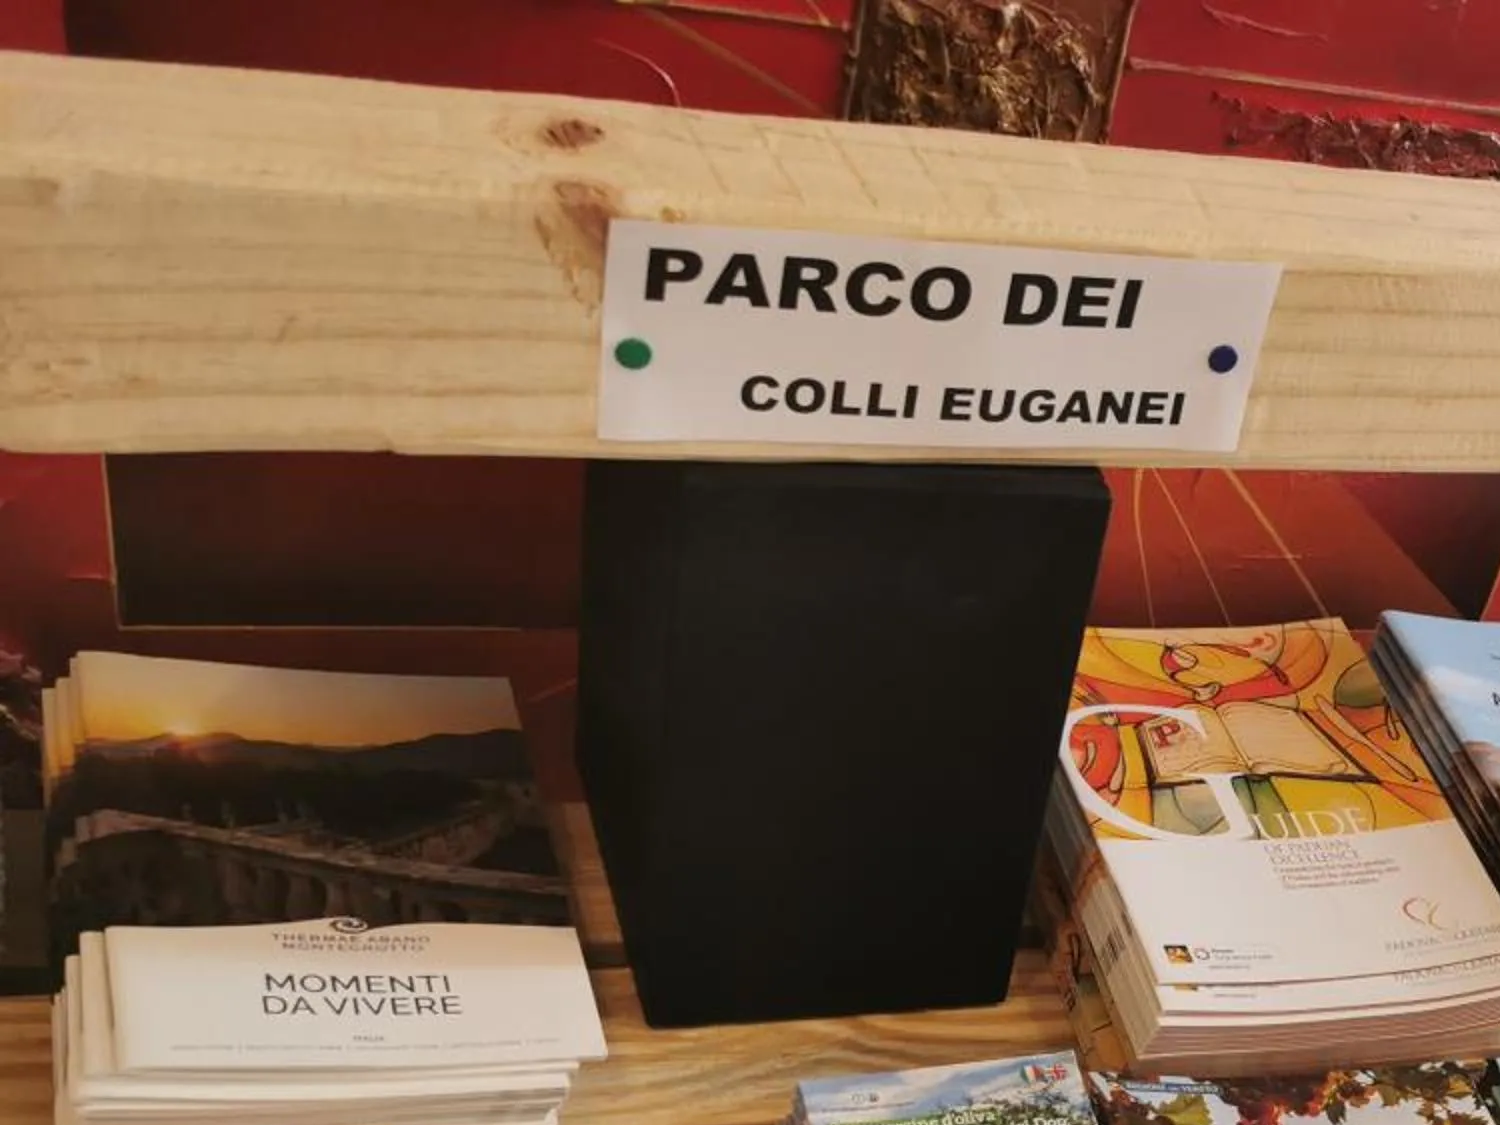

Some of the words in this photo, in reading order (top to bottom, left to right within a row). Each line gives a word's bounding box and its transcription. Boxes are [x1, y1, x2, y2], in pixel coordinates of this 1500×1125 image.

[644, 247, 972, 322] PARCO
[1003, 273, 1144, 329] DEI
[740, 375, 919, 420] COLLI
[940, 386, 1186, 426] EUGANEI
[265, 973, 451, 994] MOMENTI
[262, 995, 317, 1015] DA
[324, 995, 463, 1016] VIVERE
